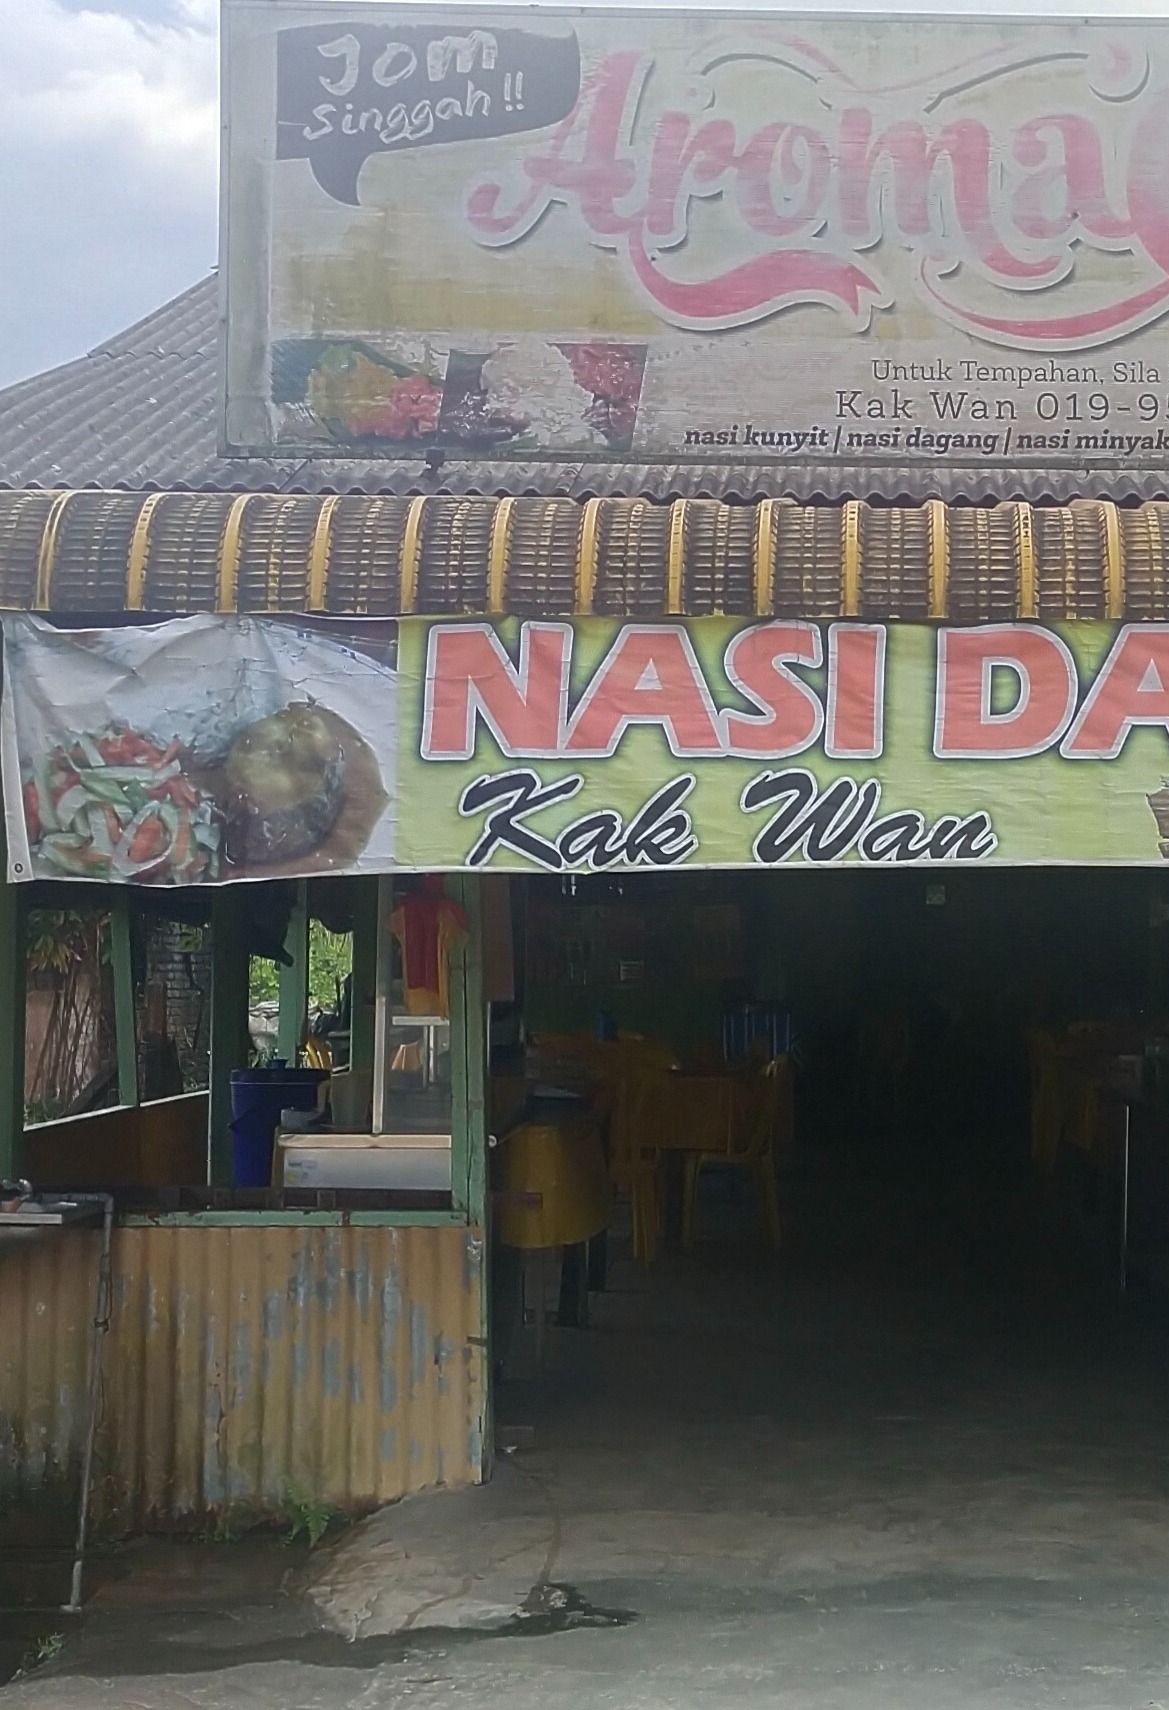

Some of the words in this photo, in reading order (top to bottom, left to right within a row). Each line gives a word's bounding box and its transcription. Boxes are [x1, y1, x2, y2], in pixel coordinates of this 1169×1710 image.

[466, 50, 1137, 320] Aroma
[835, 389, 913, 420] Kak
[930, 391, 1017, 420] Wan
[872, 359, 952, 381] Untuk
[960, 360, 1104, 389] Tempahan,
[1113, 362, 1160, 383] Sila
[684, 424, 739, 446] nasi
[743, 424, 829, 453] kunyit
[846, 427, 900, 448] nasi
[905, 427, 1000, 455] dagang
[1016, 429, 1071, 450] nasi
[420, 622, 887, 760] NASI
[458, 769, 698, 868] Kak
[740, 769, 998, 863] Wan
